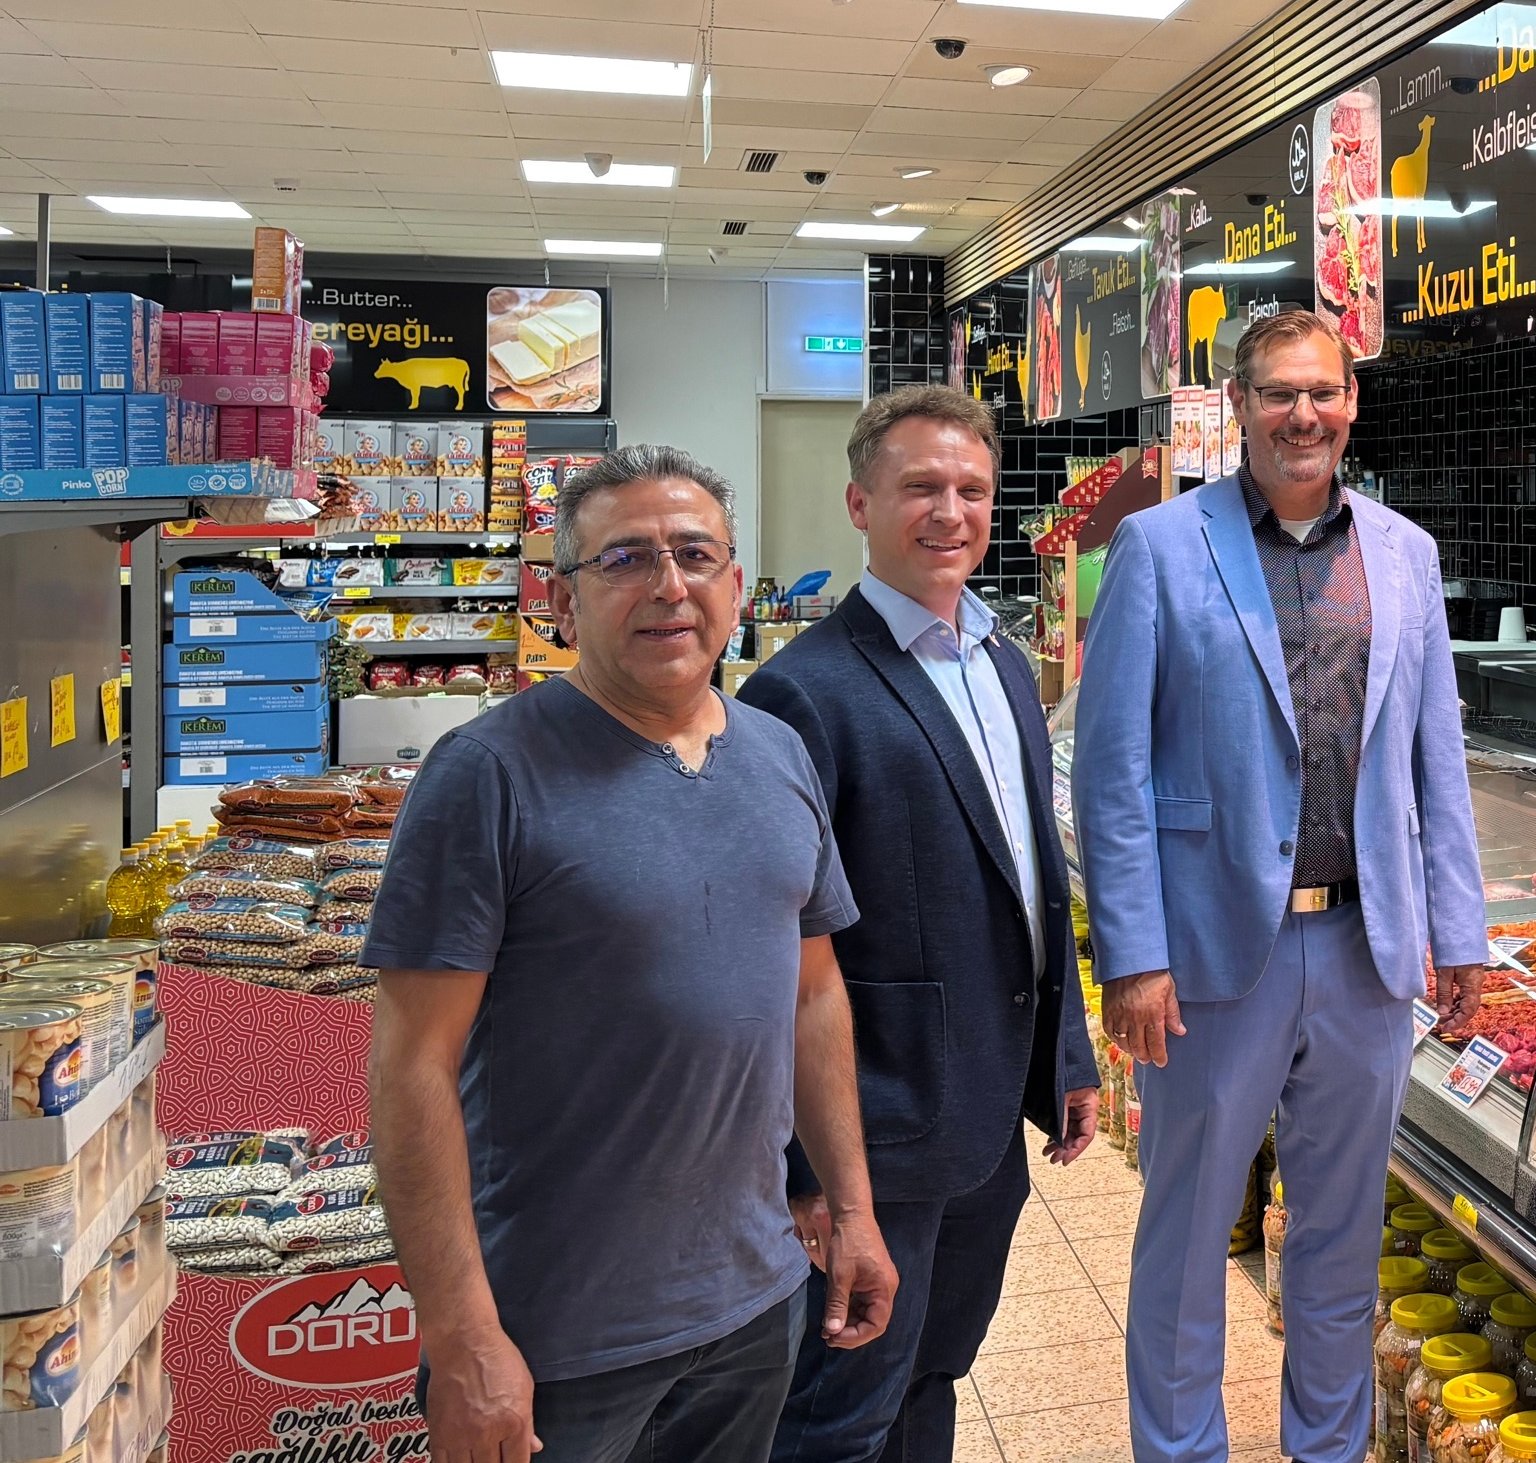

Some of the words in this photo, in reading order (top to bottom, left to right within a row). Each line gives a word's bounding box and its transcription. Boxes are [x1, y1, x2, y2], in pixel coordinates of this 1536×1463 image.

[1390, 65, 1451, 114] ...Lamm...
[1185, 202, 1212, 232] ...Kalb...
[1264, 200, 1297, 252] Eti...
[1087, 267, 1115, 303] ...Tavuk
[1117, 256, 1136, 291] Eti...
[1402, 261, 1475, 324] ...Kuzu
[1482, 236, 1536, 306] Eti...
[306, 288, 413, 309] ...Butter...
[312, 318, 454, 349] ereyağı...
[160, 377, 182, 392] OP
[62, 479, 92, 490] Pinko
[94, 467, 128, 486] POP
[98, 482, 126, 495] CORN
[193, 582, 232, 593] KEREM
[183, 651, 222, 662] KEREM
[182, 721, 223, 733] KEREM
[267, 1310, 417, 1357] DORU
[273, 1401, 353, 1437] Doğal
[361, 1396, 422, 1423] besle
